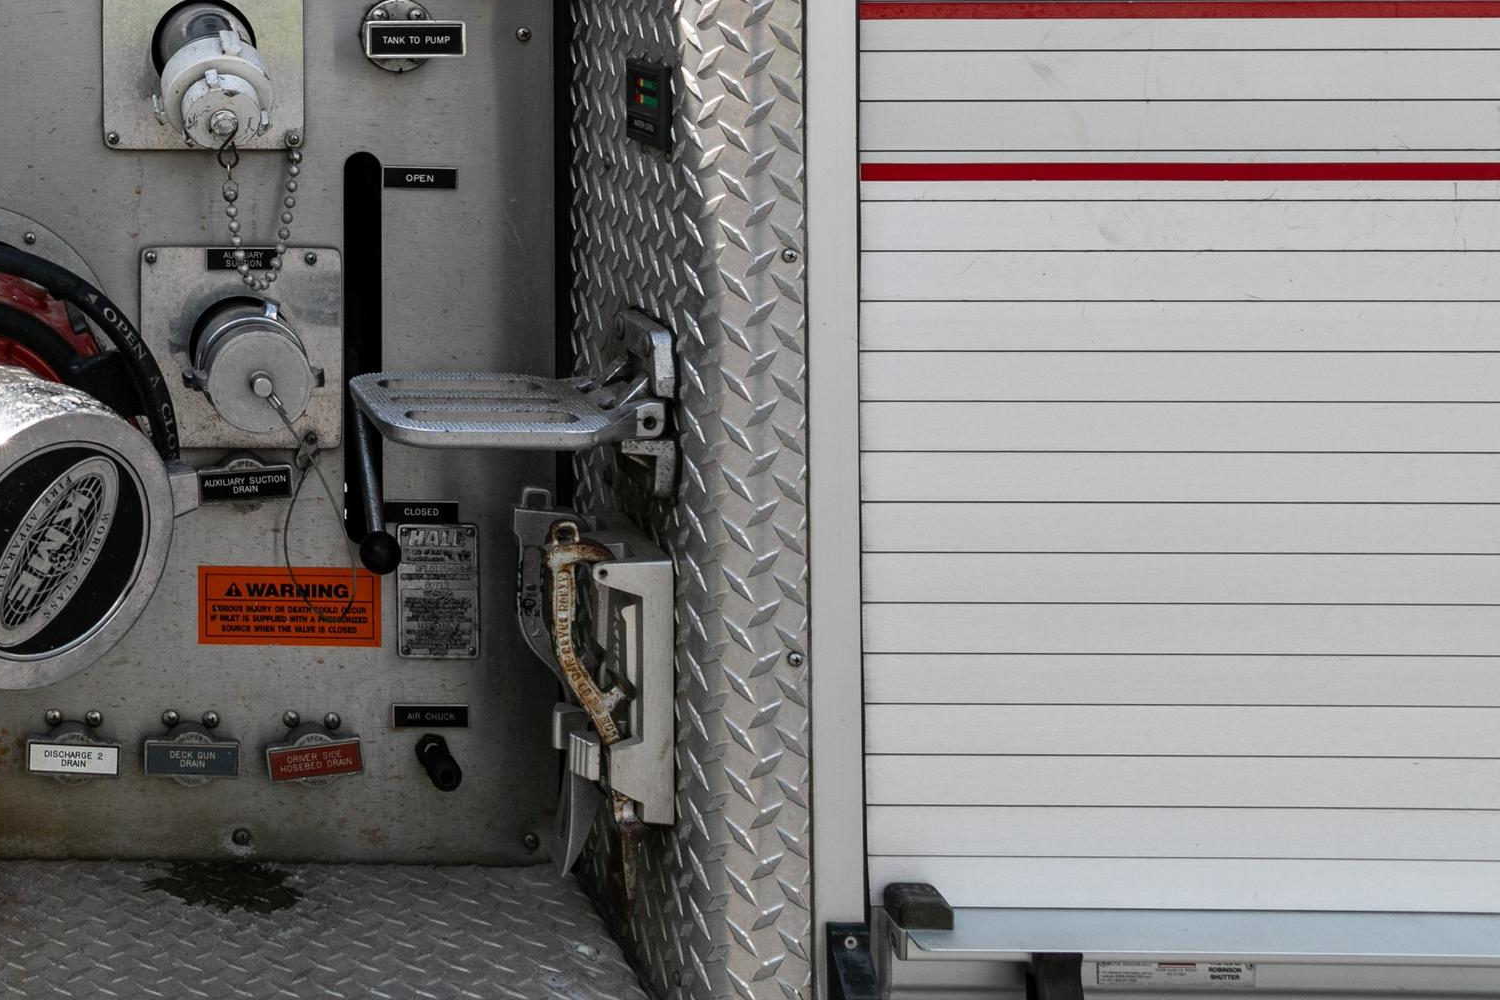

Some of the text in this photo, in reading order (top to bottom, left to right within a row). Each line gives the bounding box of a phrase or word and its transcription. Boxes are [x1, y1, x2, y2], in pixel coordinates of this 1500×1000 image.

[382, 36, 450, 44] TANK TO PUMP
[406, 174, 434, 182] OPEN
[223, 251, 263, 259] AUIARY
[103, 307, 147, 359] OPEN
[204, 474, 287, 487] AUXILIARY SUCTION
[42, 475, 73, 507] FIRE
[233, 485, 259, 494] DRAIN
[404, 508, 439, 516] CLOSED
[43, 512, 110, 619] WORLD CLASS
[246, 583, 349, 598] WARNING
[328, 626, 357, 634] CLOSED
[425, 713, 456, 721] CHUCK
[44, 750, 103, 760] DISCHARGE 2
[169, 751, 216, 760] DECK GUN
[286, 750, 343, 765] DRIVER SIDE
[61, 759, 86, 767] DRAIN
[180, 759, 205, 768] DRAIN
[280, 758, 352, 773] HOSEBED DRAIN
